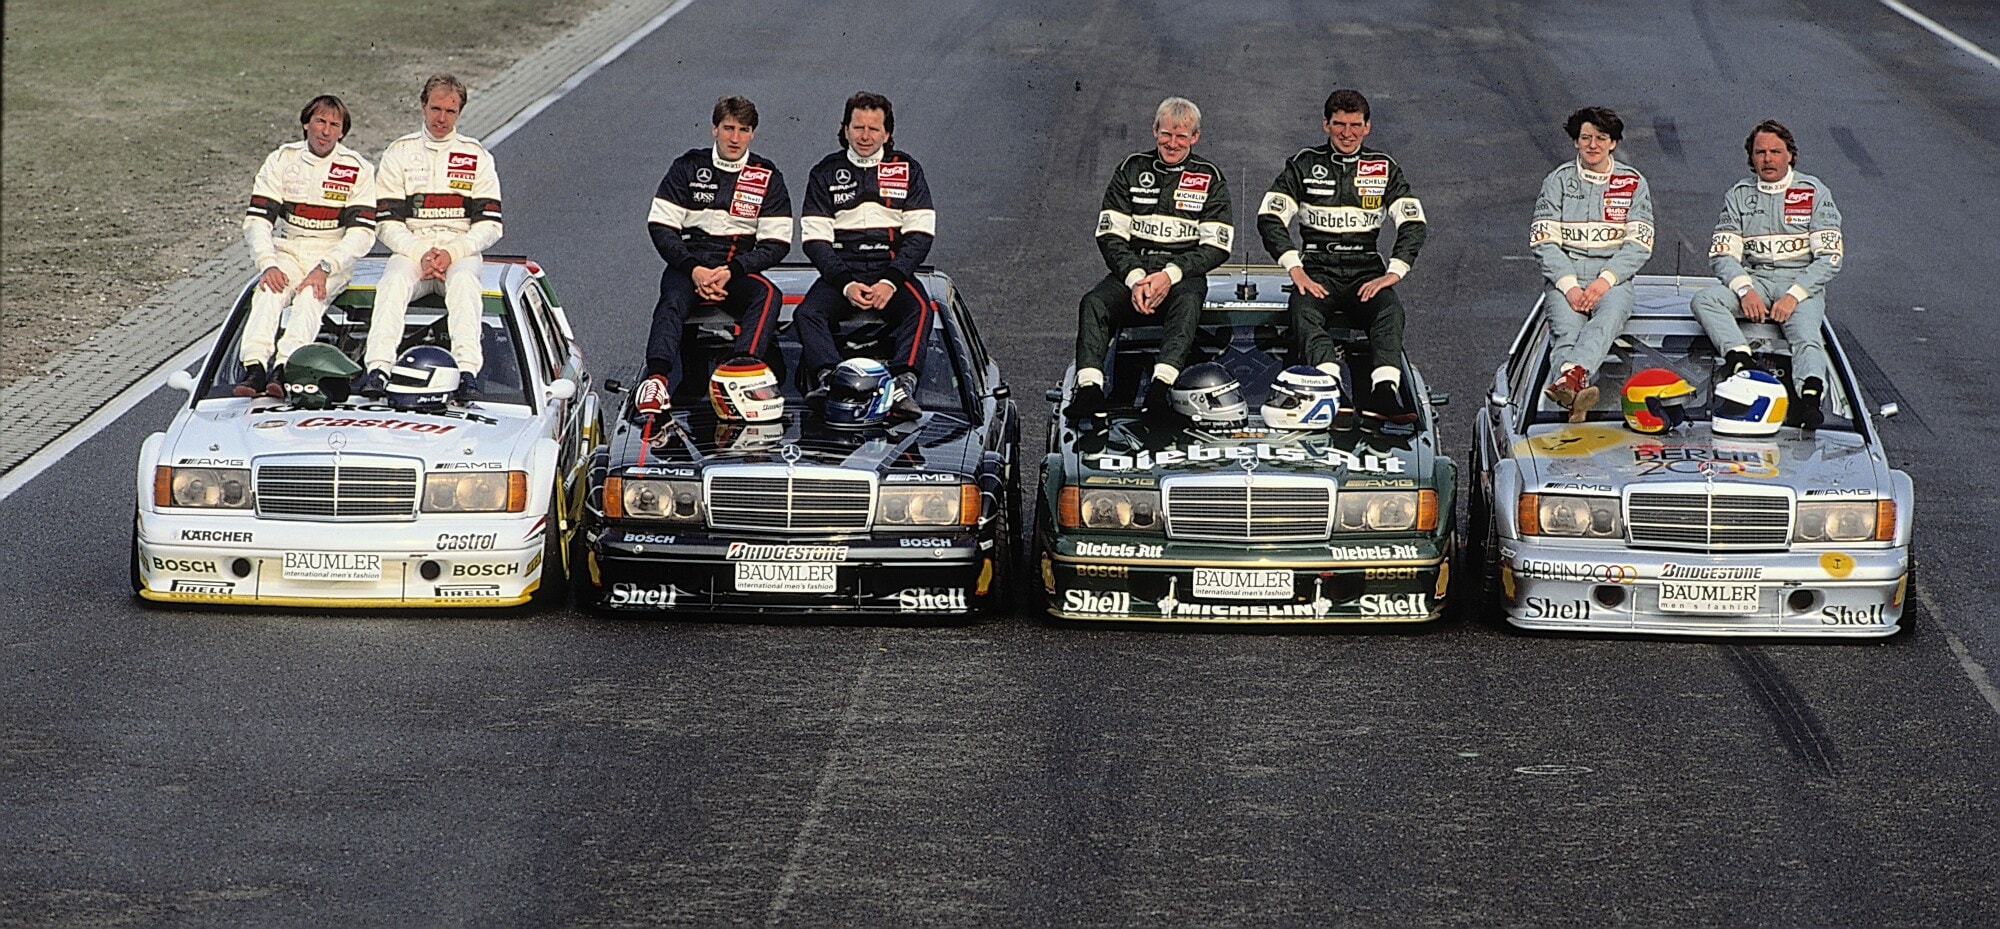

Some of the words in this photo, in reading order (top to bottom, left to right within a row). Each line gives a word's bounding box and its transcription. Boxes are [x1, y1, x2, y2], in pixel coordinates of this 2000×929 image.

[1176, 192, 1206, 201] MICHELIN
[1562, 228, 1589, 241] ERLIN
[297, 417, 456, 435] Castrol
[1634, 448, 1775, 466] BERLIN
[646, 467, 694, 476] AMG
[906, 474, 954, 482] AMG
[1105, 477, 1155, 486] AMG
[1365, 479, 1414, 487] AMG
[1564, 484, 1612, 492] AMG
[181, 529, 253, 543] KÄRCHER
[436, 532, 497, 550] Castrol
[624, 534, 675, 543] BOSCH
[900, 538, 952, 547] BOSCH
[153, 556, 217, 574] BOSCH
[284, 552, 380, 570] BÄUMLER
[453, 562, 519, 577] BOSCH
[737, 563, 834, 581] BÄUMLER
[1076, 564, 1129, 578] BOSCH
[1365, 568, 1417, 581] BOSCH
[1522, 559, 1577, 580] BERLIN
[1581, 564, 1638, 584] 2000
[1661, 563, 1762, 580] BRIDGESTONE
[170, 579, 236, 595] PIRELLI
[1195, 570, 1292, 588] BÄUMLER
[434, 584, 500, 597] PIRELLI
[609, 582, 677, 606] Shell
[900, 587, 968, 610] Shell
[1195, 588, 1241, 596] international
[1264, 589, 1291, 597] fashion
[1662, 583, 1757, 601] BÄUMLER
[1063, 589, 1131, 613] Shell
[1177, 602, 1314, 616] MICHELIN
[1359, 593, 1429, 617] Shell
[1525, 597, 1591, 620] Shell
[1821, 603, 1886, 626] Shell
